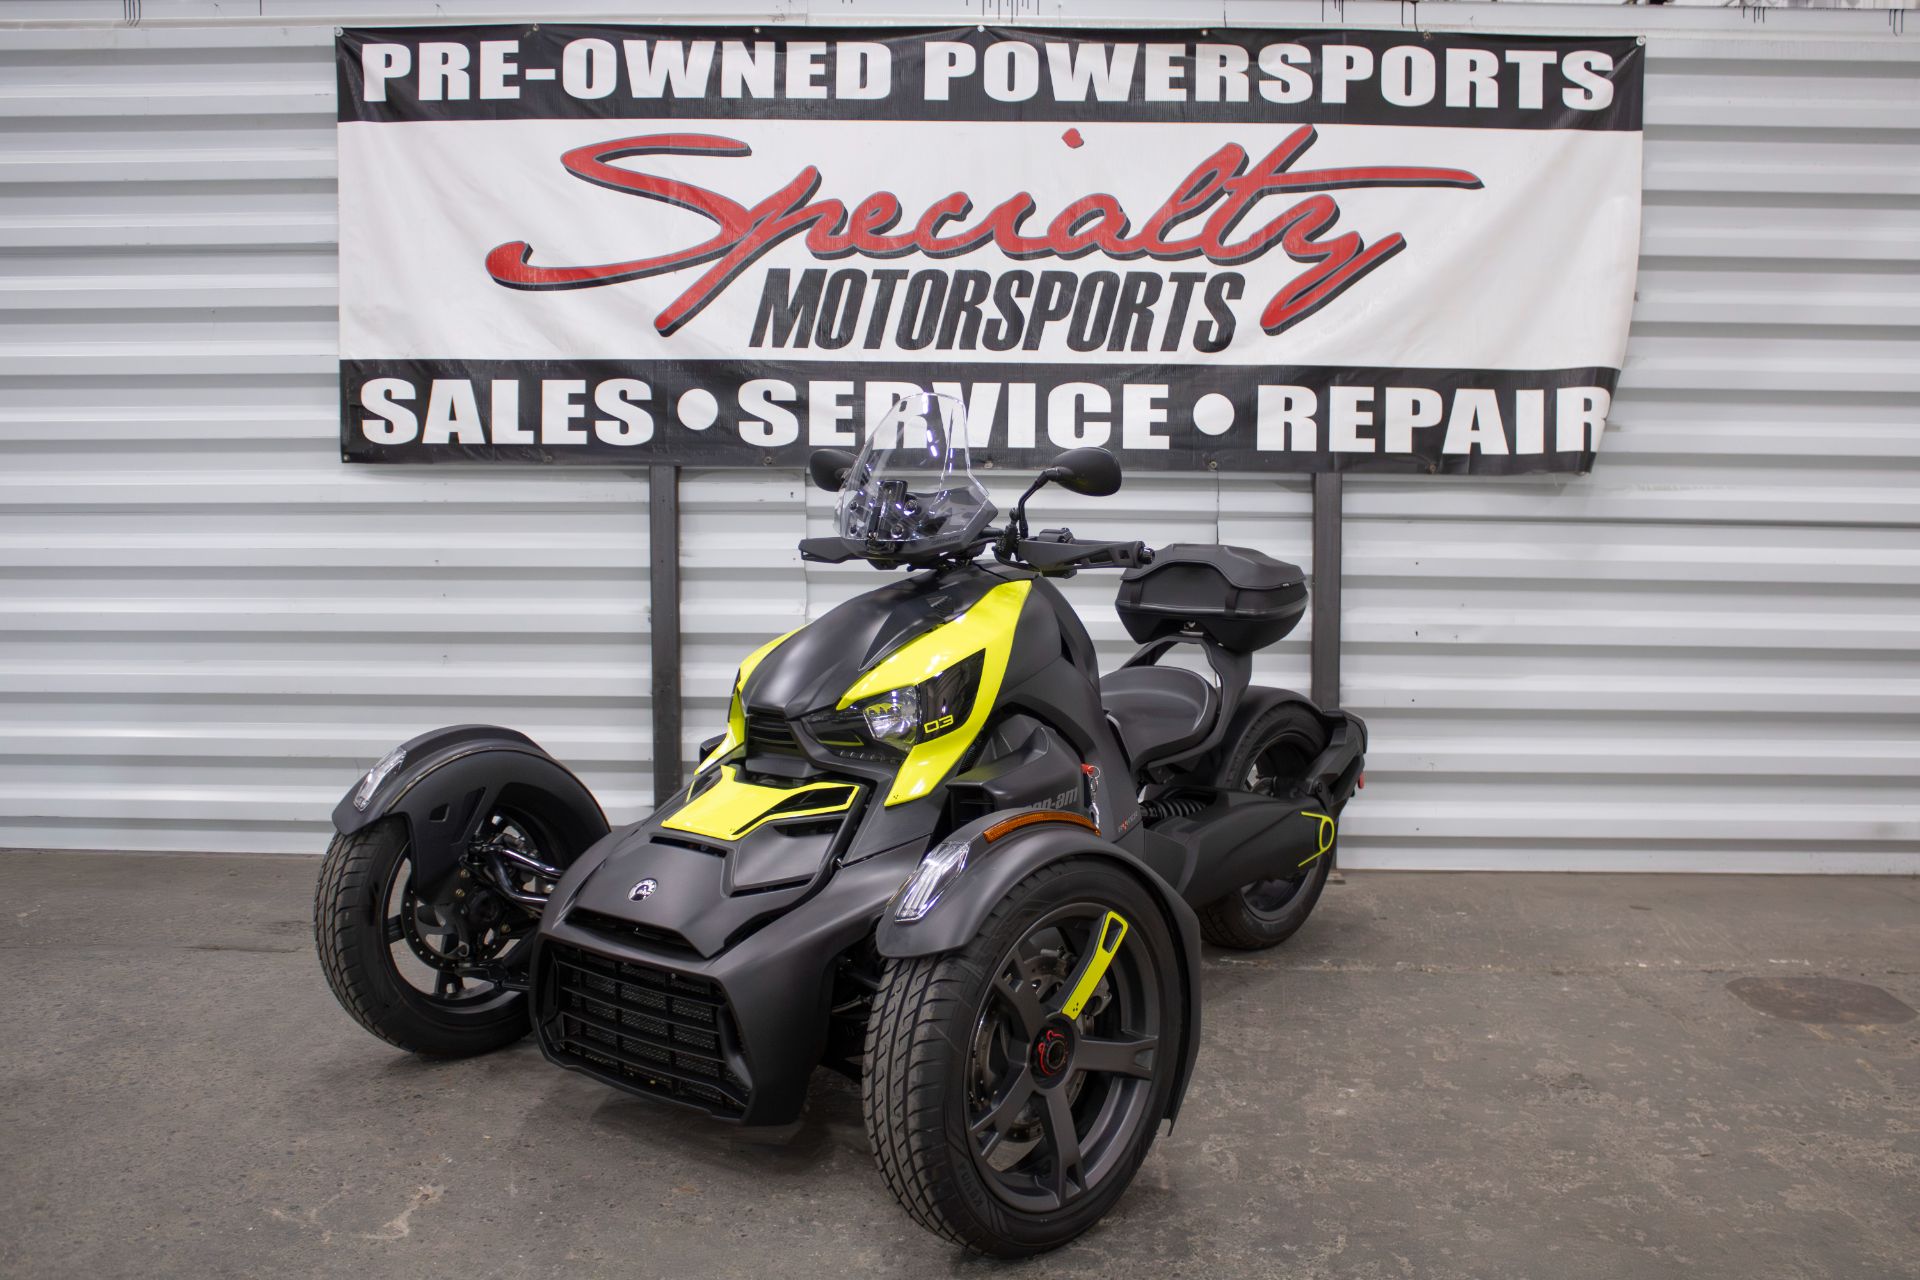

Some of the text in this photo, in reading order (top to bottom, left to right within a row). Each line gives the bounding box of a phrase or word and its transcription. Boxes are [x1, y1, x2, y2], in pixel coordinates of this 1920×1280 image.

[361, 38, 1614, 111] PRE-OWNED POWERSPORTS
[485, 124, 1485, 337] Specialty
[748, 267, 1245, 352] MOTORSPORTS
[361, 378, 1611, 456] SALES SERVICE REPAIR
[923, 714, 954, 733] 03
[1027, 787, 1078, 810] an-am
